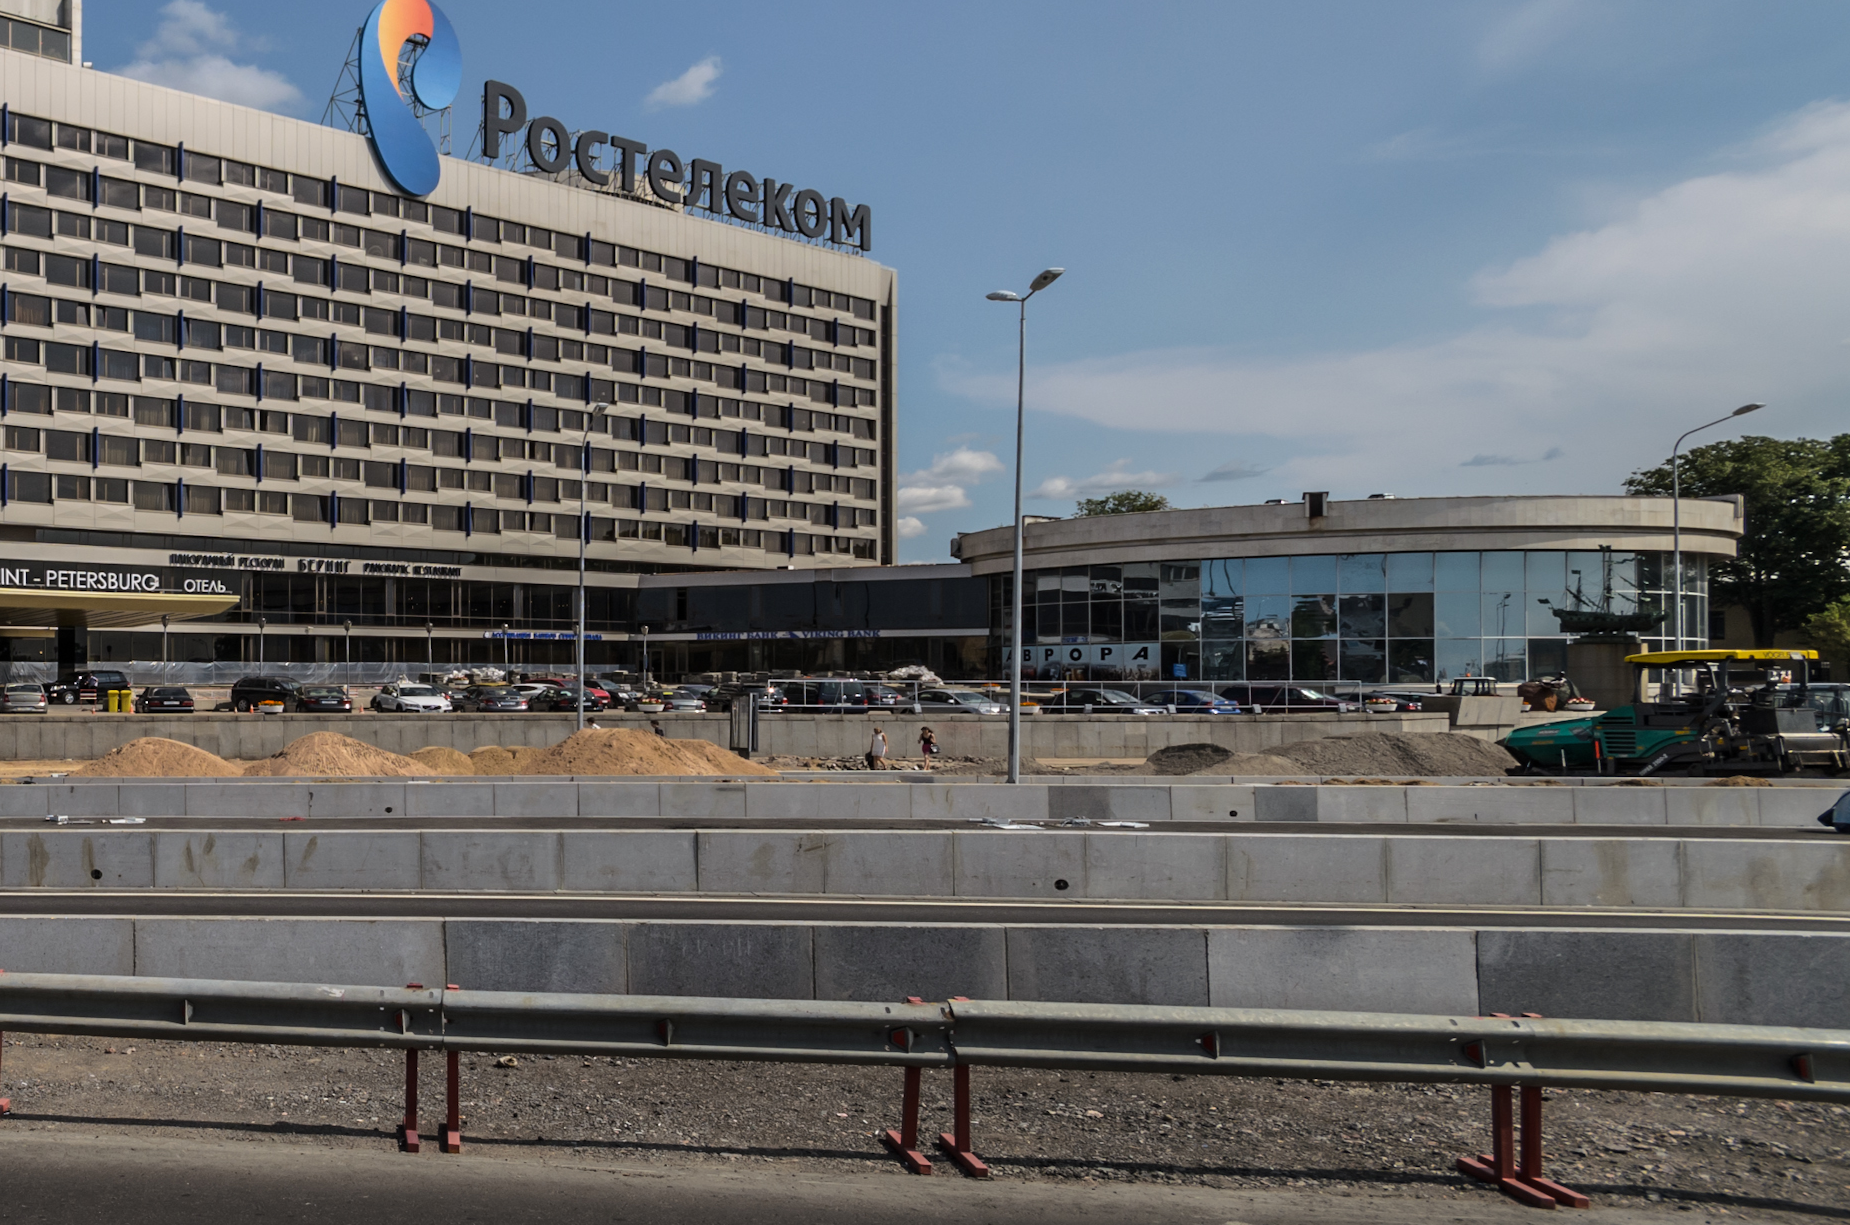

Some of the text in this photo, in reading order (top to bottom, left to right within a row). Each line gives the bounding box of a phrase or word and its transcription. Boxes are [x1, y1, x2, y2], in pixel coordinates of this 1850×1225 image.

[483, 79, 871, 252] Ростелеком
[46, 570, 159, 592] PETERSBURG
[184, 579, 226, 593] ОТЕЛЬ
[696, 631, 779, 640] ВИКИНГ БАНК
[801, 630, 844, 638] VIKING
